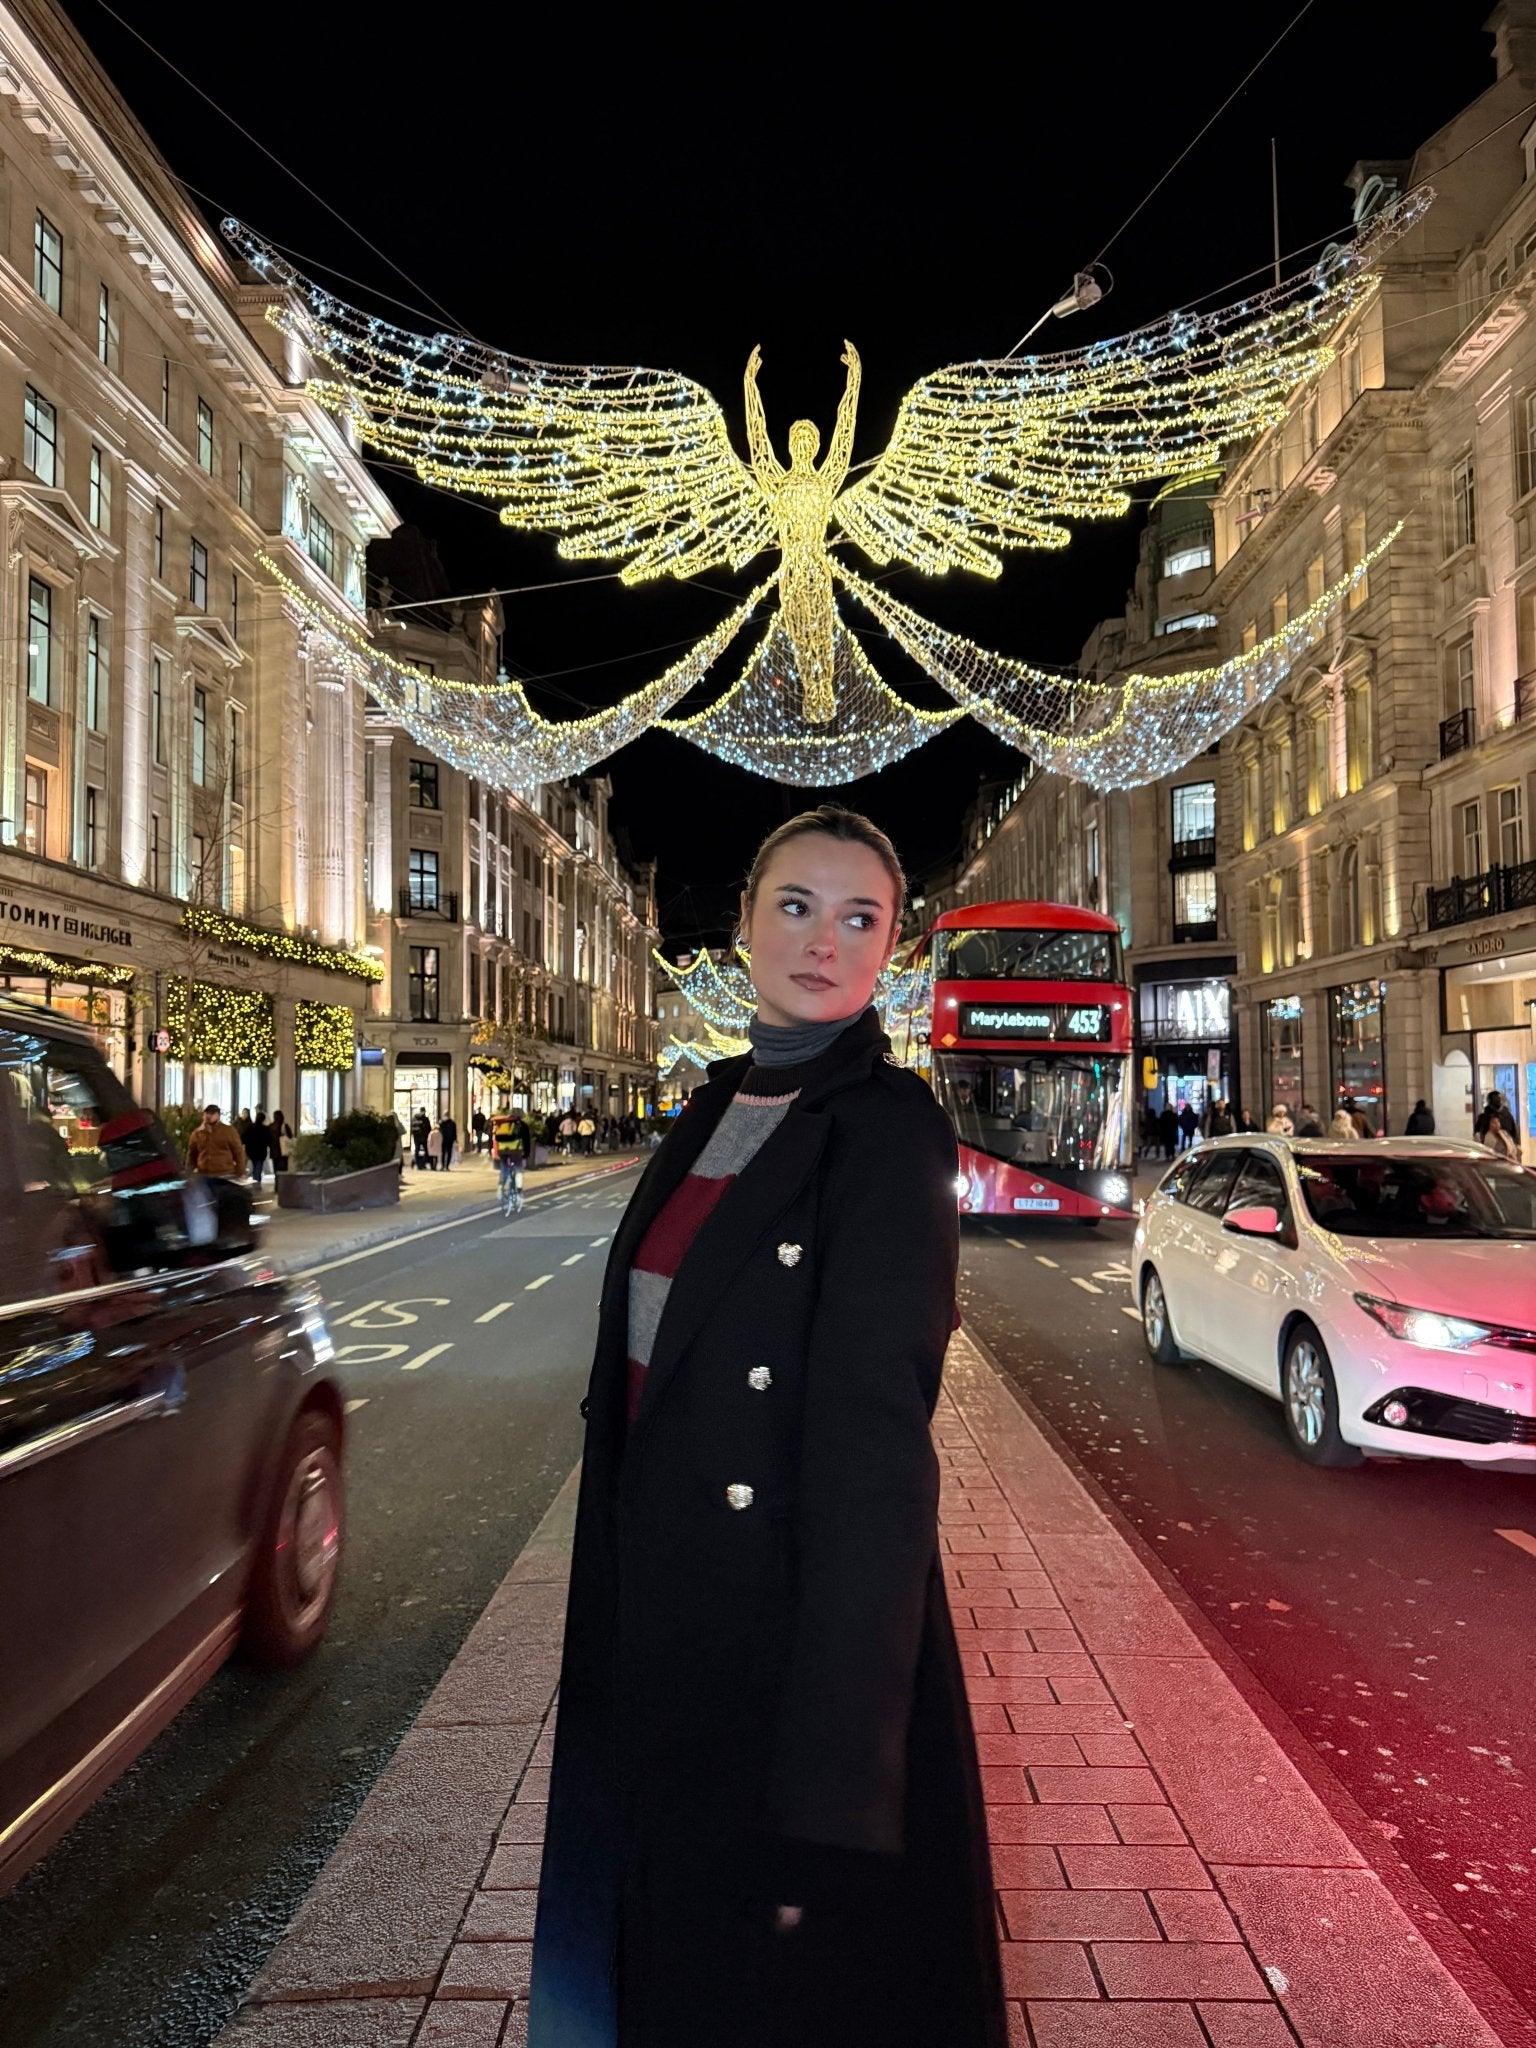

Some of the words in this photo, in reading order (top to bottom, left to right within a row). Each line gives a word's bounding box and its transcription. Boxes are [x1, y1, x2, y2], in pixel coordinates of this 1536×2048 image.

[0, 902, 61, 931] TOMMY
[81, 921, 132, 947] HILFIGER
[1464, 937, 1505, 957] SANDRO
[971, 1011, 1051, 1029] Marylebone
[1068, 1010, 1101, 1034] 453
[325, 1298, 451, 1328] US
